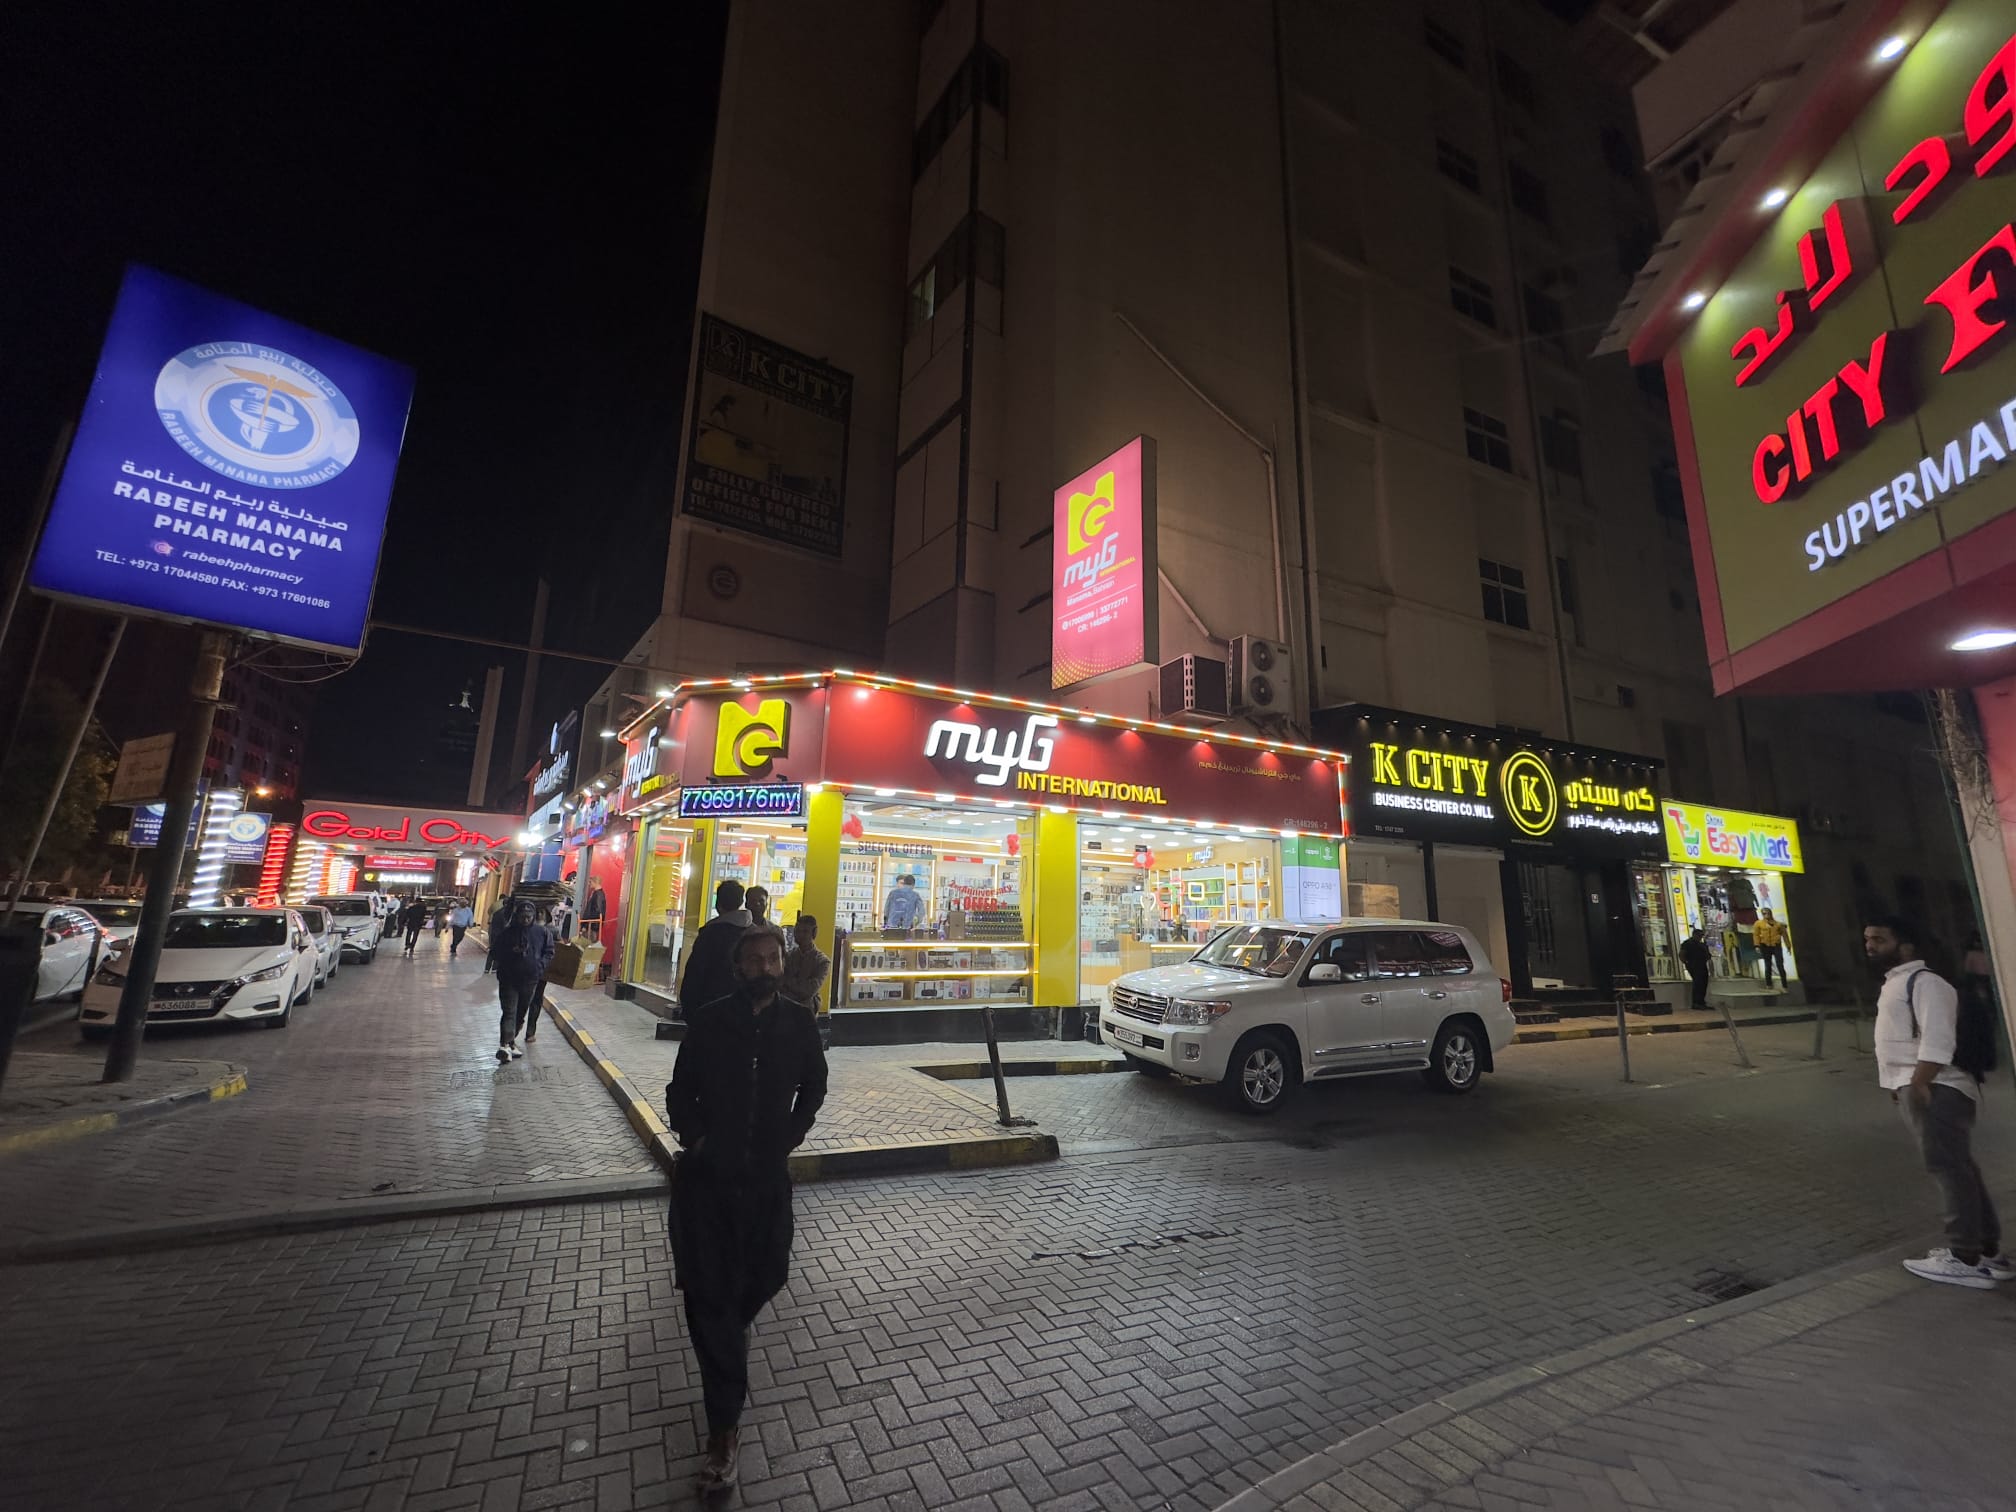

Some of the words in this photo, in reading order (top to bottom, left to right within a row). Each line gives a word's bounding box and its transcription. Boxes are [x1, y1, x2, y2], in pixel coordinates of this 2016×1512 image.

[778, 362, 848, 408] CITY
[1751, 332, 1888, 504] CITY
[161, 412, 204, 457] RABEEH
[203, 455, 268, 486] MANAMA
[274, 462, 341, 487] PHARMACY
[121, 460, 211, 494] المنامة
[113, 481, 227, 522] RABEEH
[235, 513, 343, 551] MANAMA
[213, 490, 264, 511] ربيع
[268, 501, 348, 531] صيدلية
[154, 514, 303, 561] PHARMACY
[96, 550, 126, 565] TEL:
[129, 558, 160, 572] +973
[163, 565, 219, 586] 17044580
[221, 578, 249, 591] FAX:
[251, 584, 278, 598] +973
[281, 591, 330, 609] 17601086
[182, 549, 303, 584] rabeehpharmacy
[1063, 532, 1119, 589] myG
[923, 714, 1059, 786] myG
[1370, 742, 1401, 786] K
[1406, 749, 1490, 797] CITY
[1016, 771, 1167, 805] INTERNATIONAL
[1373, 792, 1423, 810] BUSINESS
[1423, 798, 1459, 815] CENTER
[1518, 774, 1543, 813] K
[1564, 777, 1620, 812] سيتي
[302, 810, 411, 842] Gold
[419, 818, 512, 849] City
[857, 840, 899, 853] SPECIAL
[903, 843, 933, 855] OFFER
[1707, 827, 1747, 862] Easy
[1749, 831, 1791, 860] Mart
[964, 896, 998, 911] OFFER
